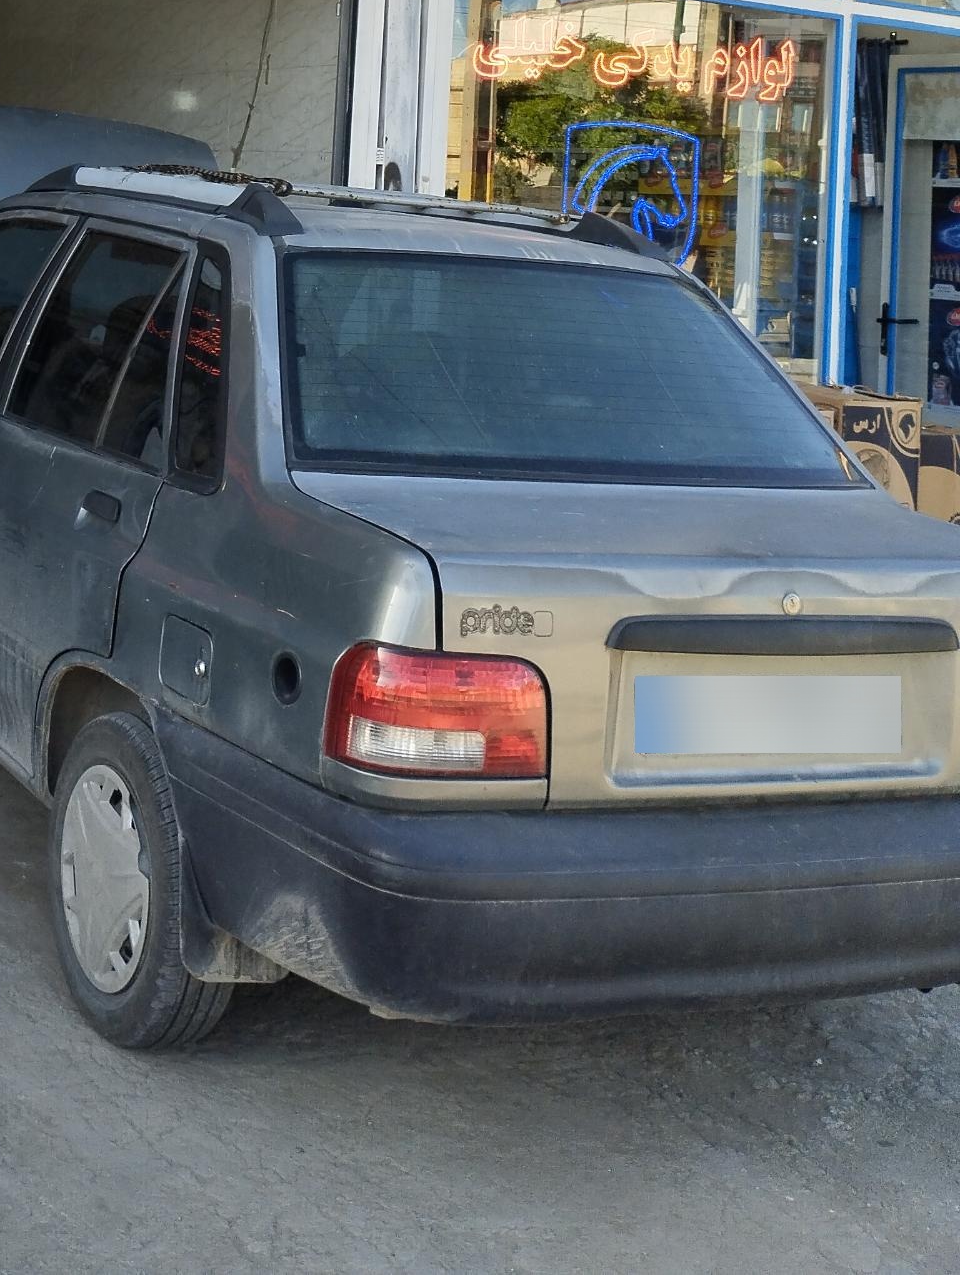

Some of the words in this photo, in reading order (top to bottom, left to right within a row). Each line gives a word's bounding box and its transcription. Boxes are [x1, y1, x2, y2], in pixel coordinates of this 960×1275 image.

[472, 15, 586, 78] خلیلی
[593, 29, 691, 93] یدکی
[703, 36, 795, 101] لوازم
[460, 604, 535, 638] pride
